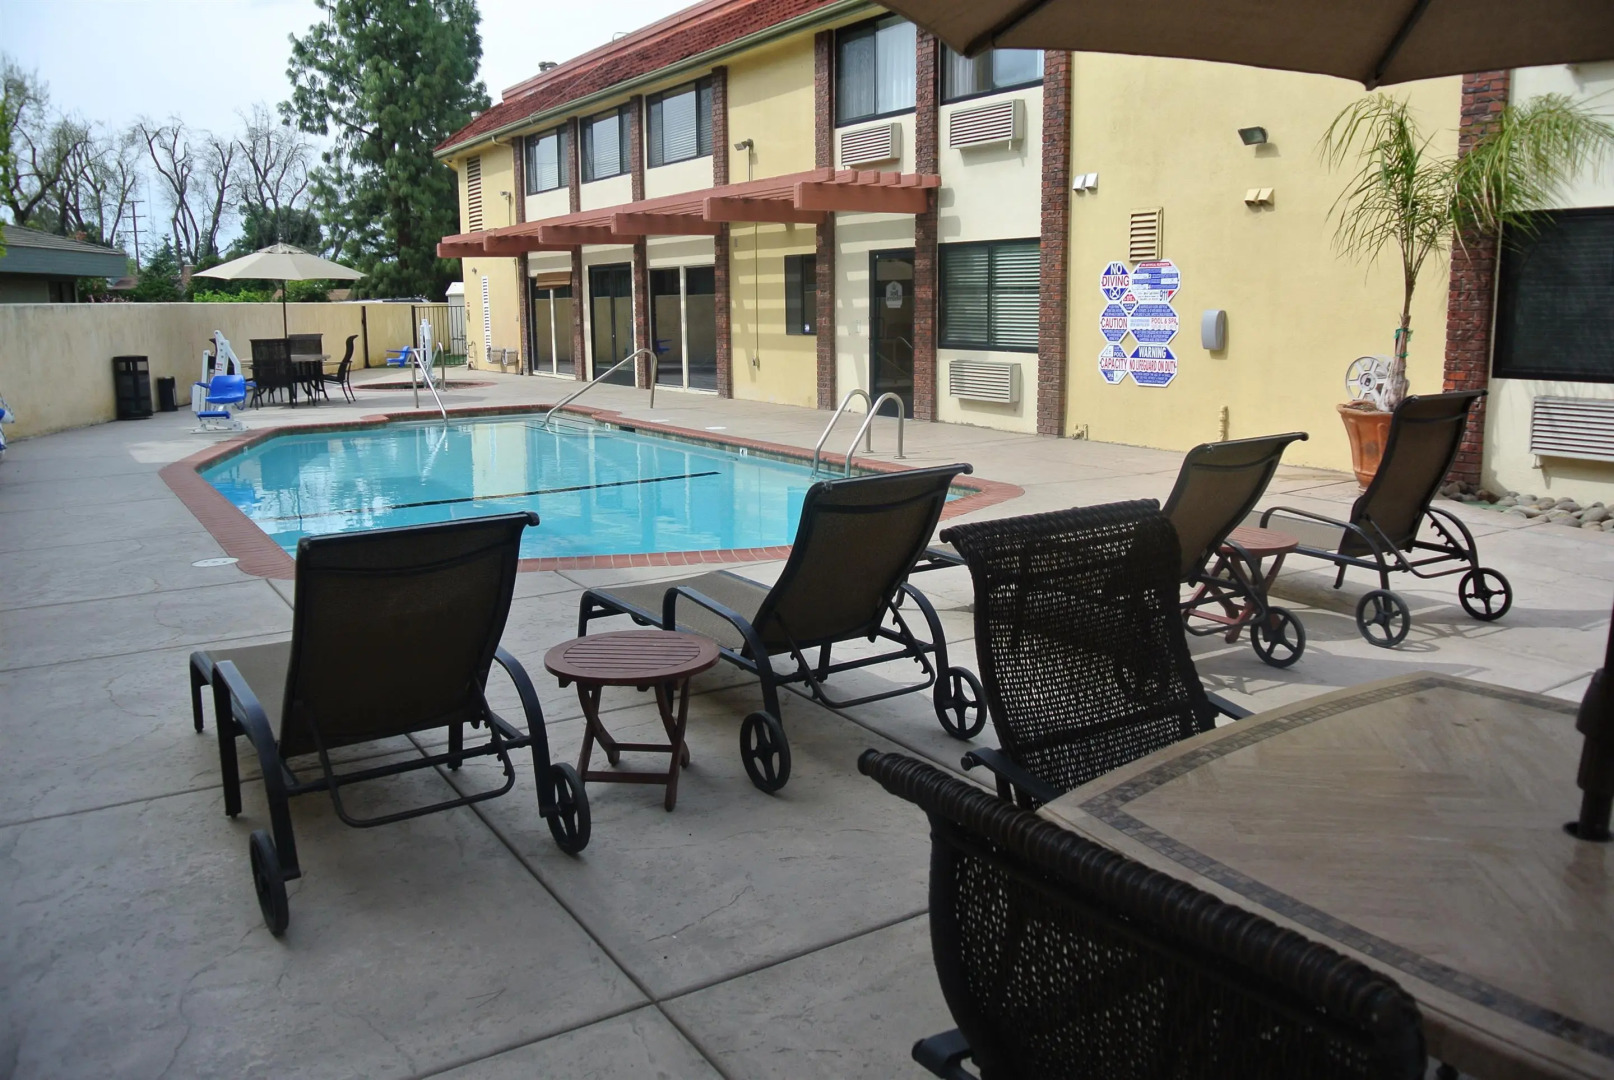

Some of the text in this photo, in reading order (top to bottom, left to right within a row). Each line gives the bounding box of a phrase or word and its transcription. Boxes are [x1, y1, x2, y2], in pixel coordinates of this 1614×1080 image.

[1110, 263, 1122, 275] NO
[1102, 276, 1129, 286] DIVING
[1101, 318, 1127, 328] CAUTION
[1139, 347, 1166, 358] WARNING
[1101, 358, 1127, 369] CAPACITY
[1130, 360, 1176, 372] NO LIFEGUARD ON DUTY
